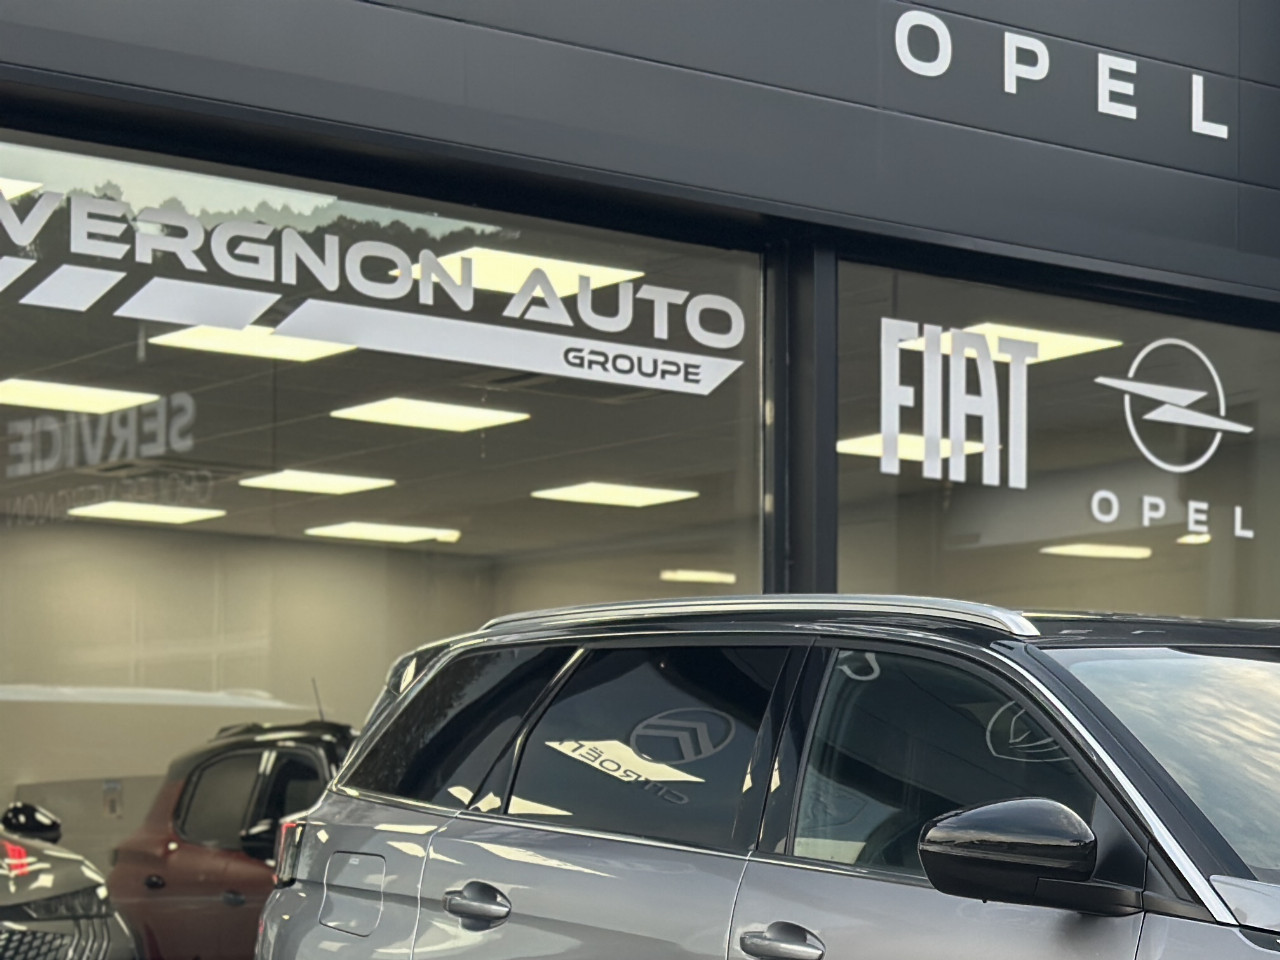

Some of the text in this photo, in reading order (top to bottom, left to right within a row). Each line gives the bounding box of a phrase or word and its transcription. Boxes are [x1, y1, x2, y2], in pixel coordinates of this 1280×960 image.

[895, 10, 1228, 139] OPEL
[0, 187, 746, 349] VERGNON AUTO
[563, 347, 702, 384] GROUPE
[880, 317, 1039, 489] FIAT
[1090, 489, 1254, 538] OPEL
